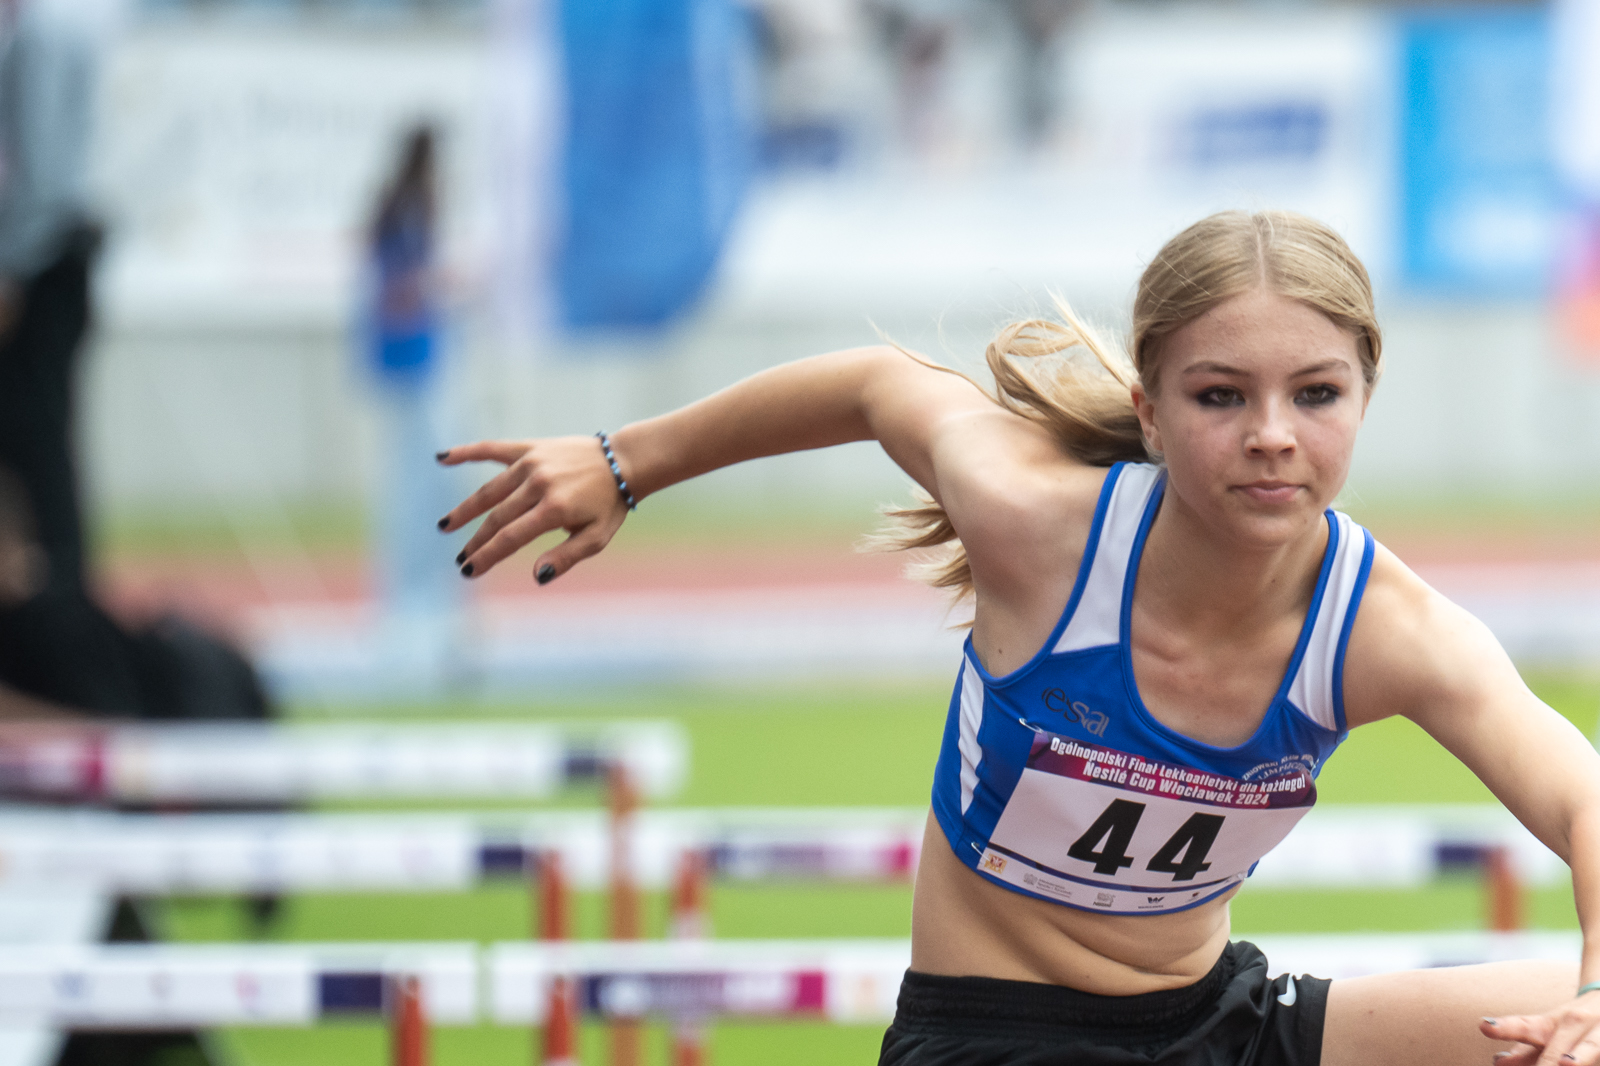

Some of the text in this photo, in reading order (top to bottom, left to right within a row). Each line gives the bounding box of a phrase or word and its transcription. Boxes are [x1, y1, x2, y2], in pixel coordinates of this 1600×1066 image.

[1050, 737, 1306, 793] Ogólnopolski Finał Lekkoatletyki dla każdego!
[1083, 761, 1270, 805] Nestlé Cup Włocławek 2024
[1067, 798, 1226, 882] 44
